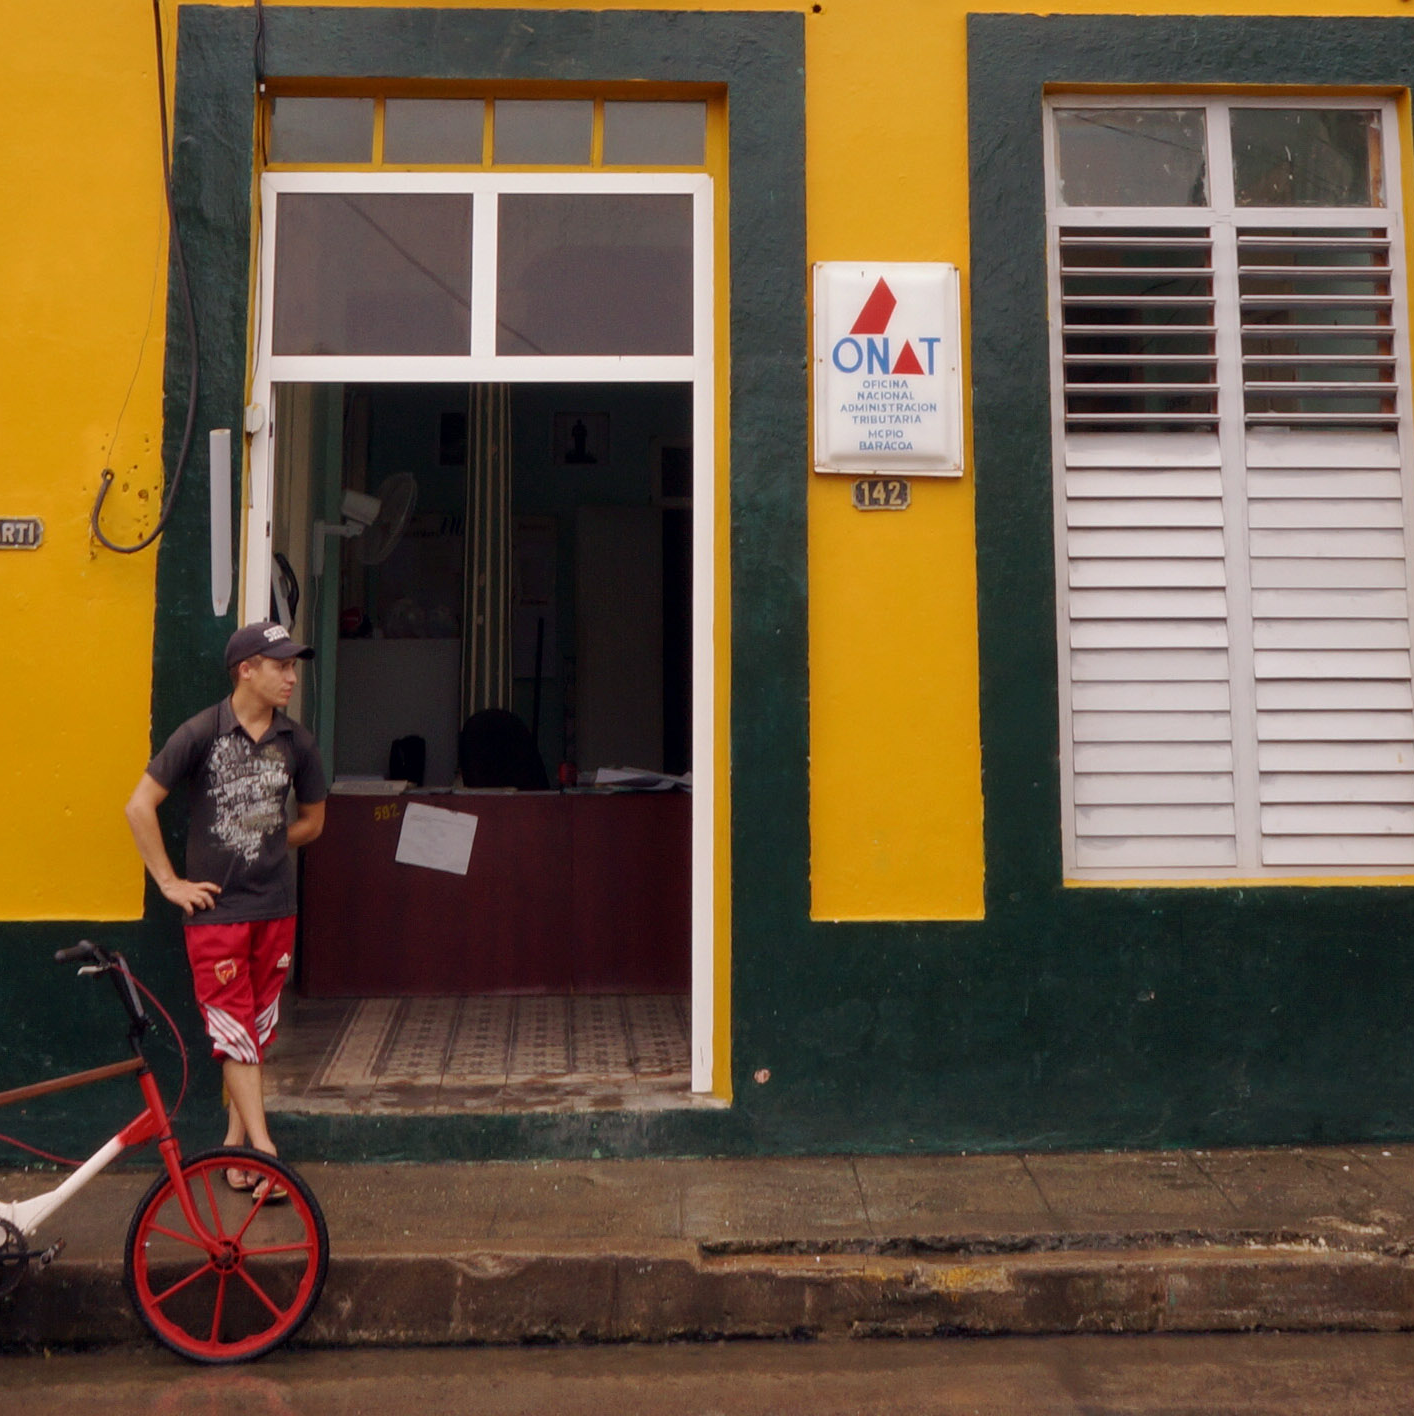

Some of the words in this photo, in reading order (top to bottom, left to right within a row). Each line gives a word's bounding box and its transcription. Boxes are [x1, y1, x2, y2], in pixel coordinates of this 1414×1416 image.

[832, 337, 941, 376] ONAT
[862, 379, 909, 389] OFICINA
[857, 391, 915, 401] NACIONAL
[840, 403, 937, 413] ADMINISTRACION
[852, 414, 922, 425] TRIBUTARIA
[868, 429, 904, 439] MCPIO
[859, 440, 913, 451] BARACOA
[860, 481, 903, 506] 142
